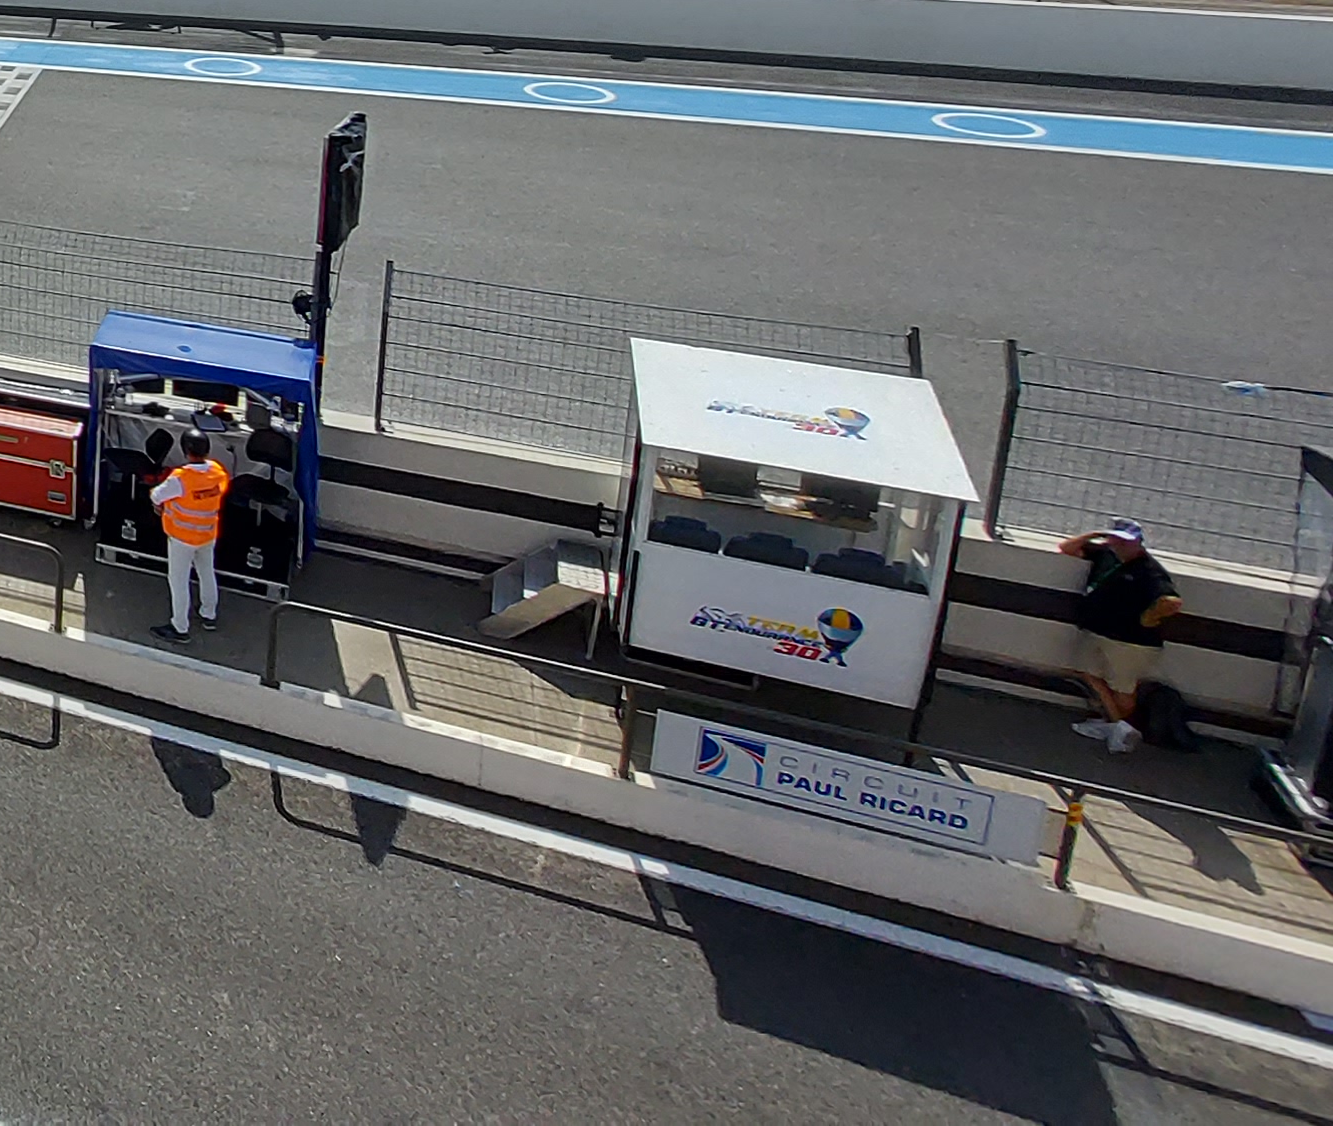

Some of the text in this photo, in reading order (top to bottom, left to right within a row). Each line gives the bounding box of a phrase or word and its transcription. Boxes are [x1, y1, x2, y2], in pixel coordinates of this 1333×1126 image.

[747, 614, 820, 640] TEAM
[773, 640, 823, 662] 30
[777, 771, 969, 830] PAUL RICARD
[778, 754, 973, 811] CIRCUIT
